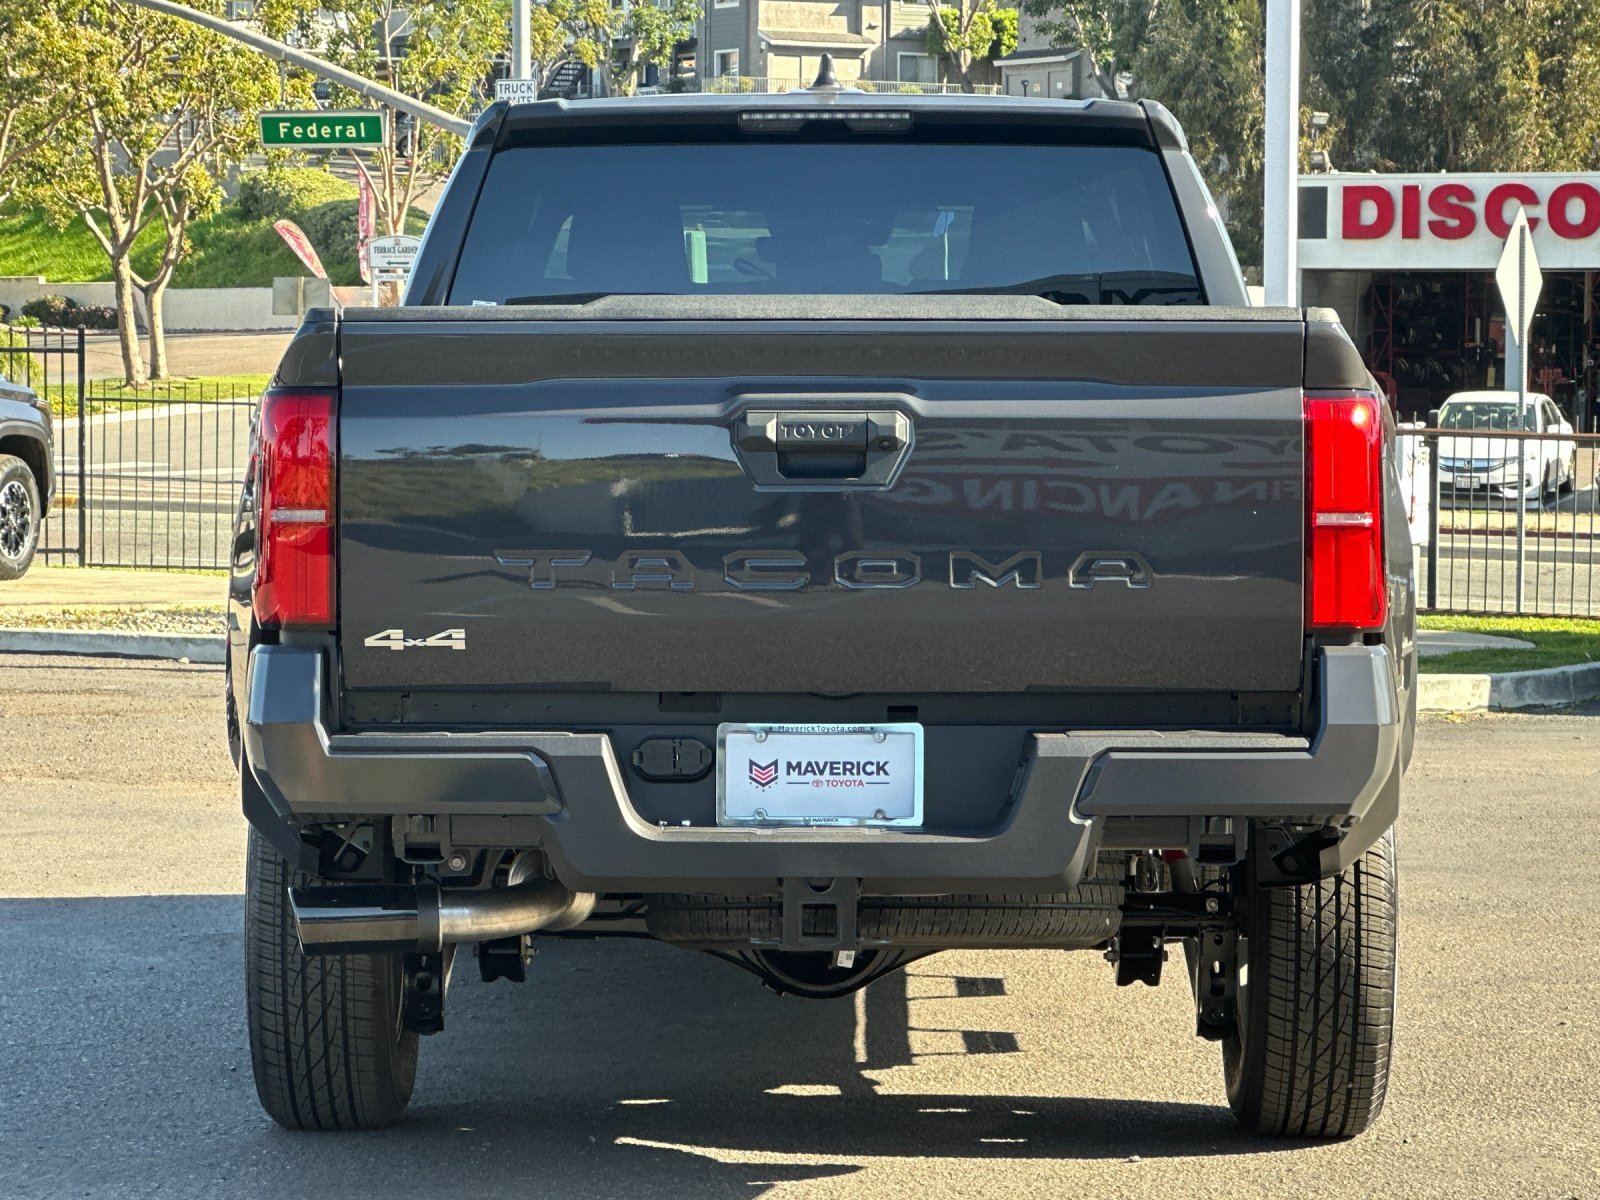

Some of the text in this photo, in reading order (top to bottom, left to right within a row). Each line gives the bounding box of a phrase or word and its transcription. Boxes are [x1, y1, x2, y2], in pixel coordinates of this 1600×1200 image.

[498, 82, 533, 94] TRUCK
[279, 122, 366, 139] Federal
[1341, 182, 1600, 240] DISCO
[373, 246, 397, 254] TERRACE
[493, 549, 1154, 591] TACOMA
[778, 725, 865, 733] MaverickToyota.com
[786, 761, 890, 776] MAVERICK
[825, 779, 865, 788] TOYOTA
